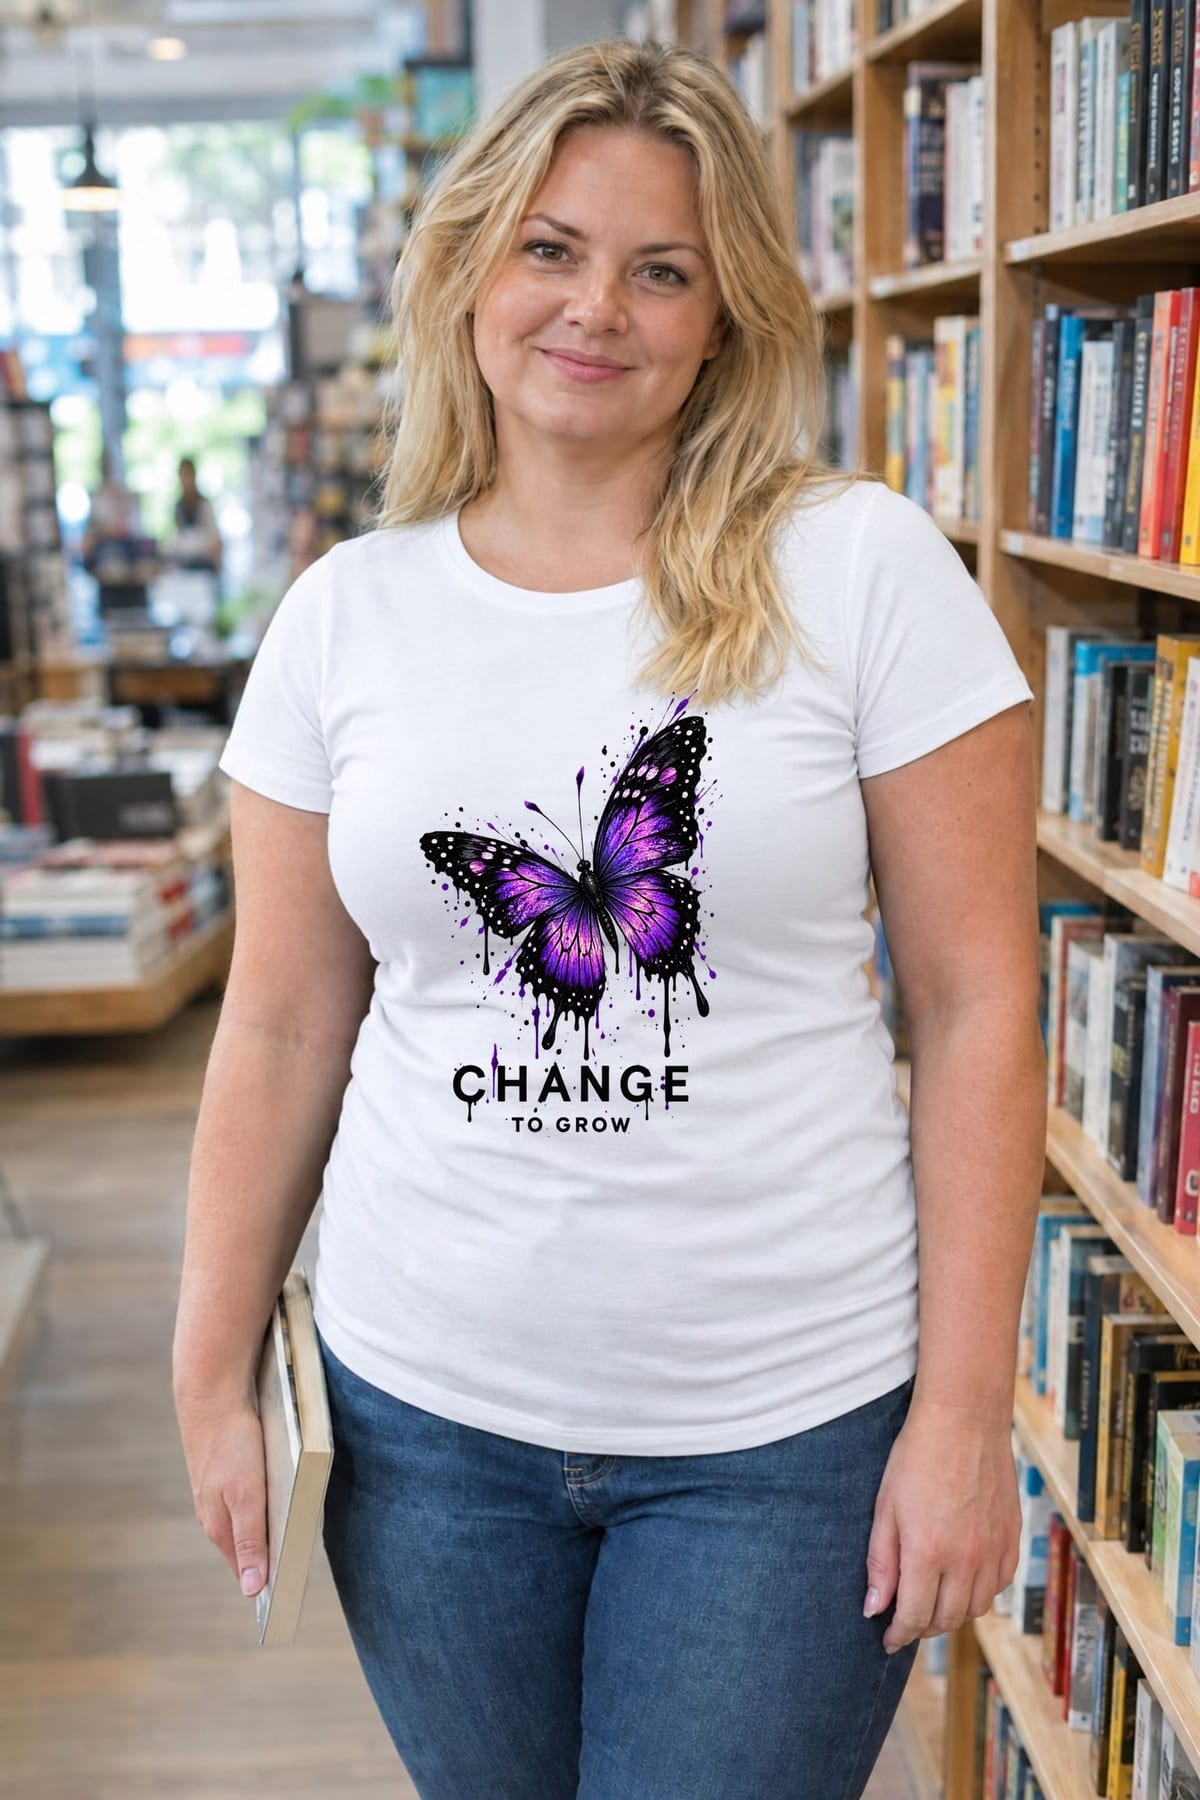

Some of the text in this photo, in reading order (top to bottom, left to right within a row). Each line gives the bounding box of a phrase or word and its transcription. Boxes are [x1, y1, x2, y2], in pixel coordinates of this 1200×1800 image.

[453, 1064, 689, 1104] CHANGE
[512, 1117, 630, 1133] TO GROW
